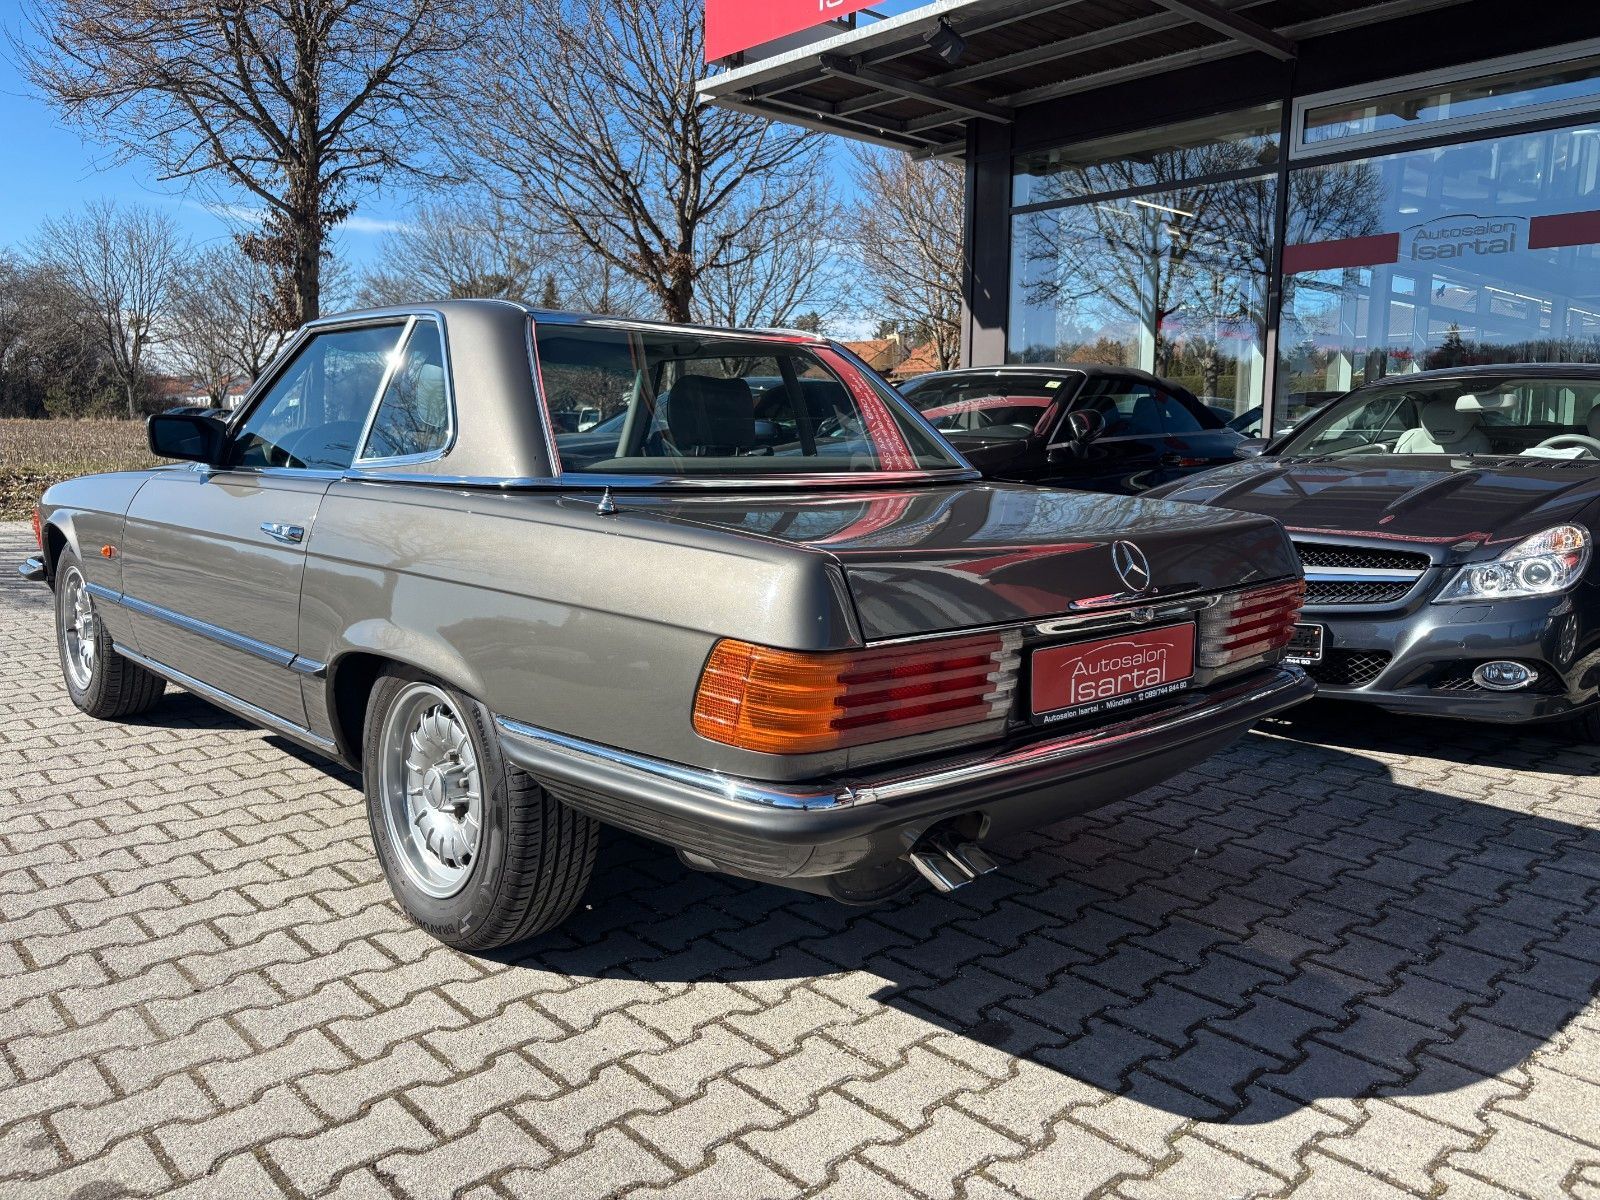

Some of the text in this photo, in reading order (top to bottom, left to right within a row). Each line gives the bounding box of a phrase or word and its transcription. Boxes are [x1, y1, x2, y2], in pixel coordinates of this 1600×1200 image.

[1412, 221, 1517, 242] Autosalon
[1411, 232, 1516, 261] Isartal
[1071, 648, 1167, 679] Autosalon
[1070, 660, 1167, 704] Isartal
[1043, 709, 1077, 723] Autosalon
[1078, 704, 1099, 716] Isartal
[1106, 696, 1132, 710] München
